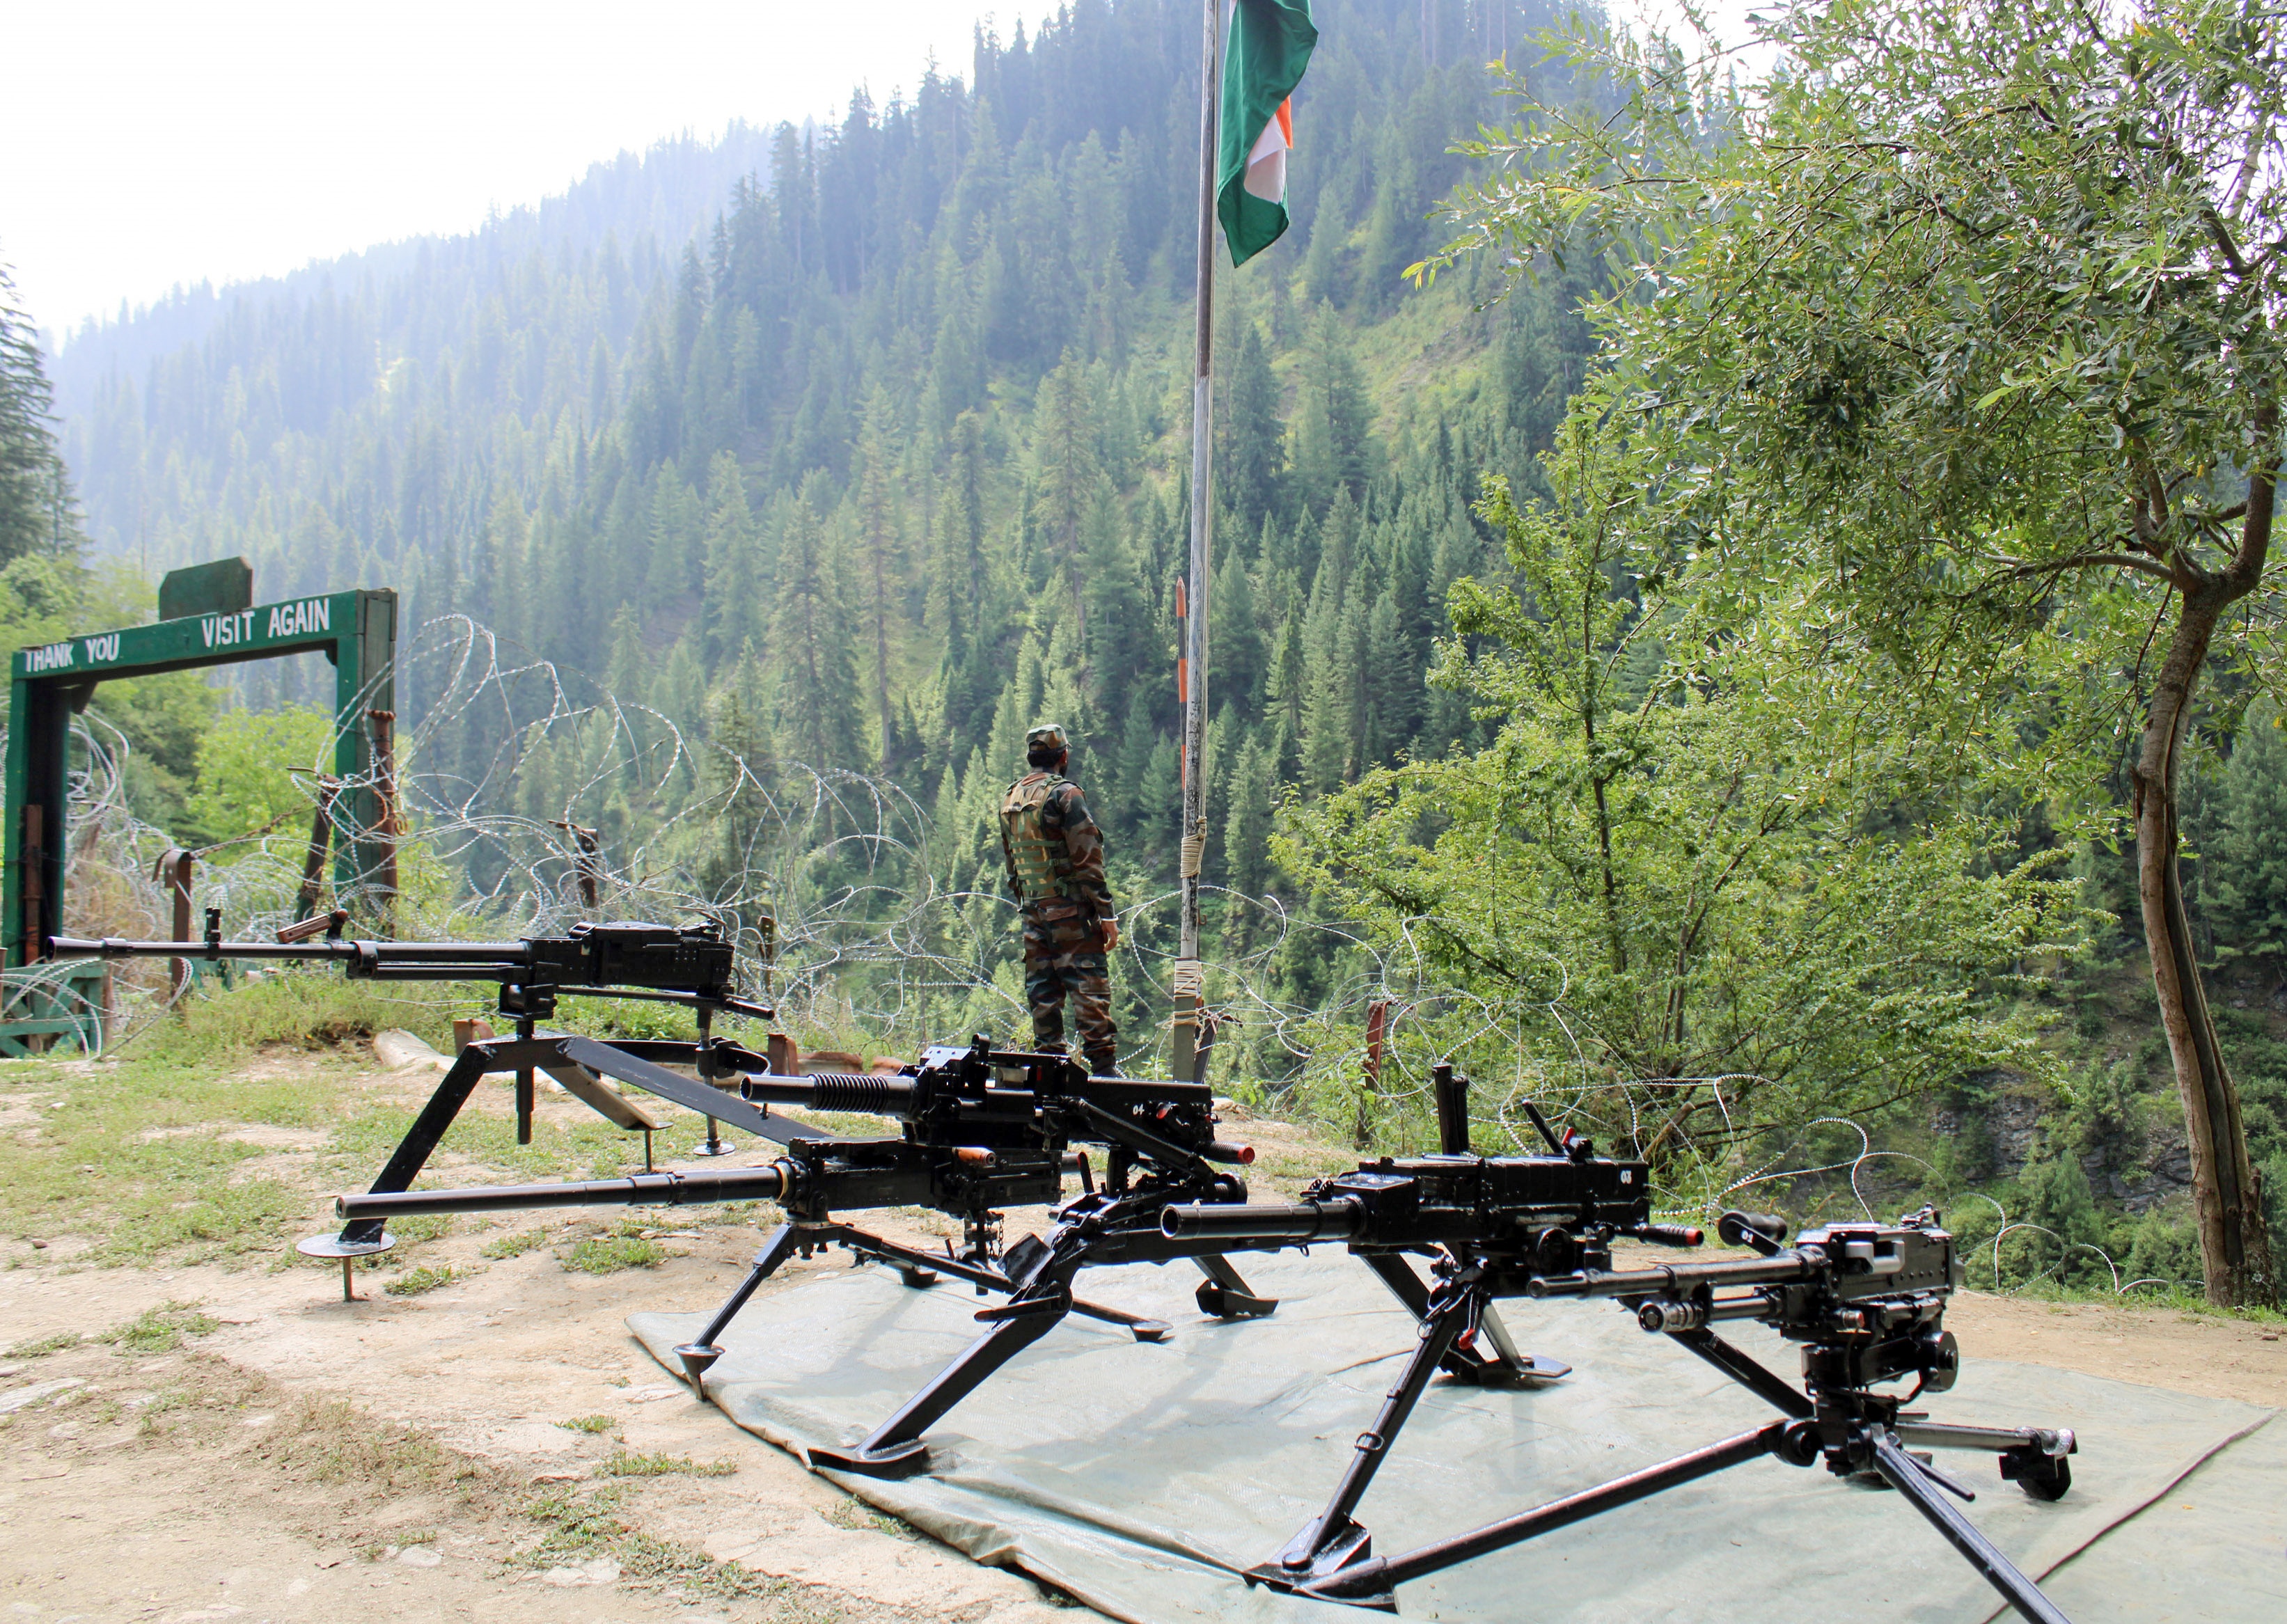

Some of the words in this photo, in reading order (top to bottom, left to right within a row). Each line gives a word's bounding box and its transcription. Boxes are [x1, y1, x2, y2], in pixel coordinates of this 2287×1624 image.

[26, 642, 74, 672] THANK
[85, 633, 120, 663] YOU
[201, 610, 256, 647] VISIT
[267, 598, 329, 638] AGAIN
[1133, 1103, 1145, 1115] 04
[1621, 1170, 1632, 1184] 03
[1741, 1230, 1753, 1243] 01
